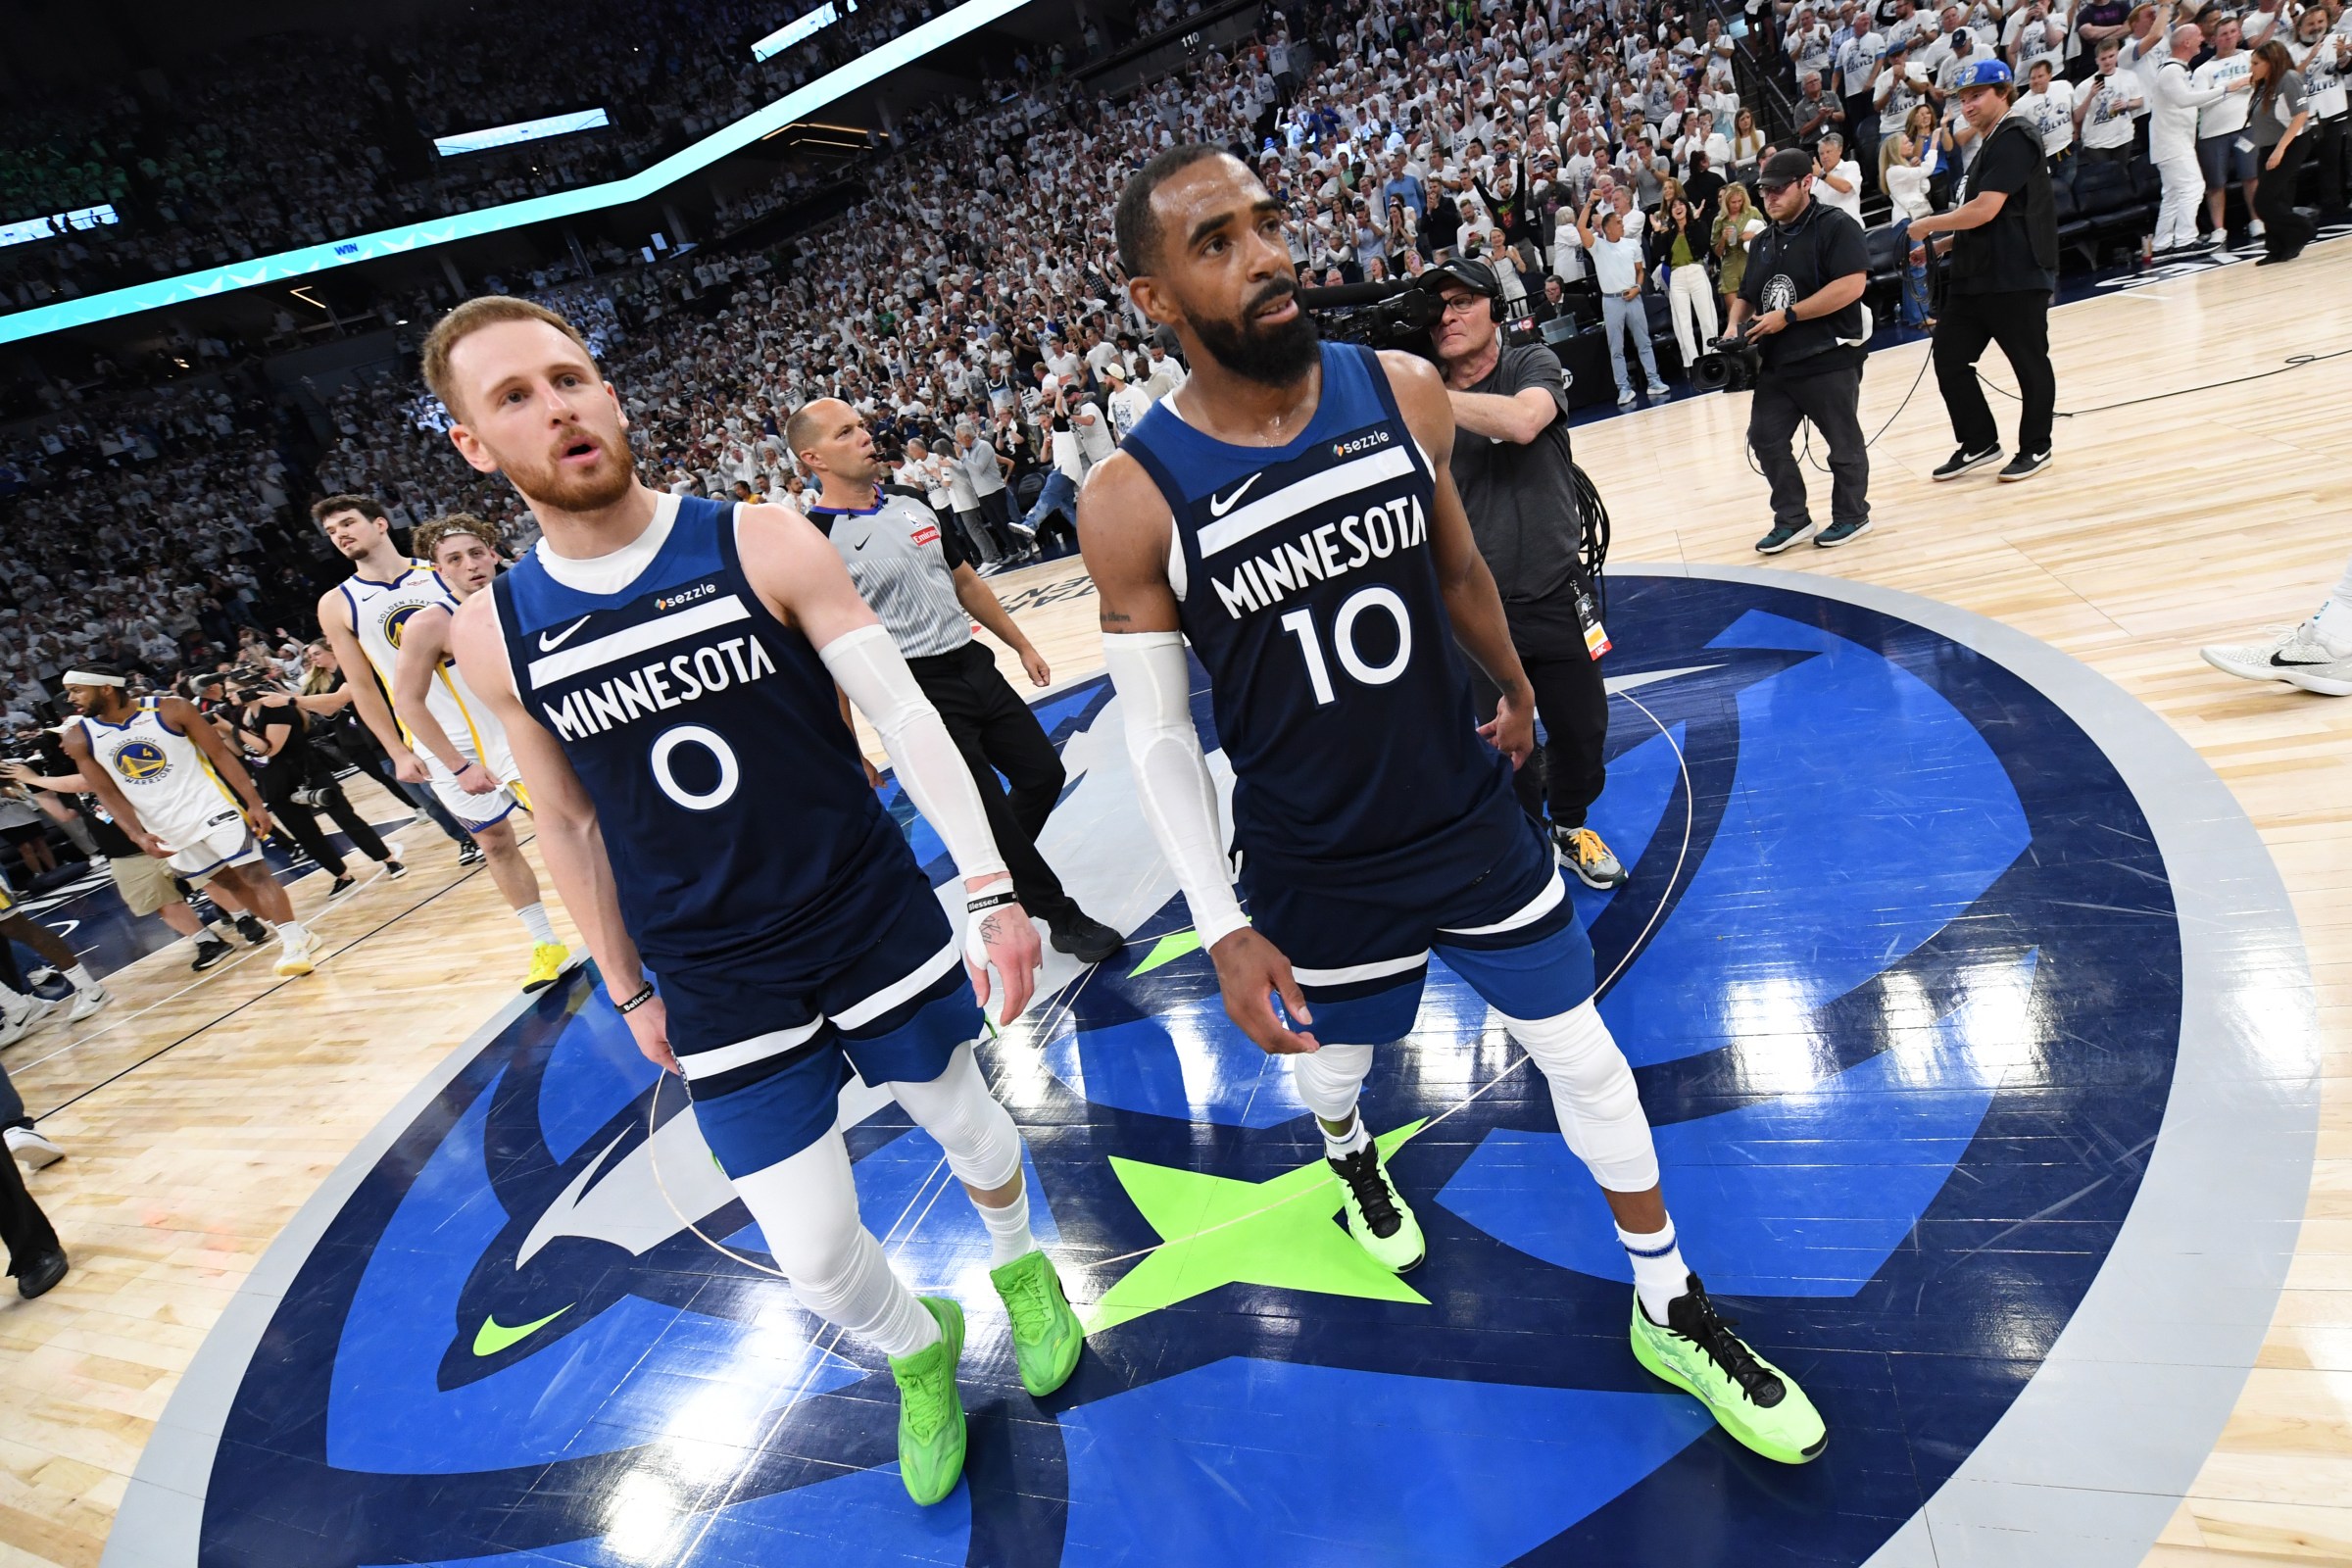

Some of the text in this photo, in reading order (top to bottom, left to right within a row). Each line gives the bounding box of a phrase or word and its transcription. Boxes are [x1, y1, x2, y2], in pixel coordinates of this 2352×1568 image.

[1181, 32, 1200, 47] 110
[334, 243, 359, 256] WIN
[1344, 430, 1390, 454] sezzle
[1210, 494, 1427, 620] MINNESOTA
[666, 583, 716, 607] sezzle
[377, 600, 405, 624] GOLDEN
[1280, 586, 1412, 706] 10
[542, 634, 777, 742] MINNESOTA
[142, 748, 153, 758] 4
[124, 763, 173, 785] WARRIORS
[650, 724, 740, 810] 0
[968, 896, 1000, 911] Blessed
[623, 990, 652, 1011] Believe
